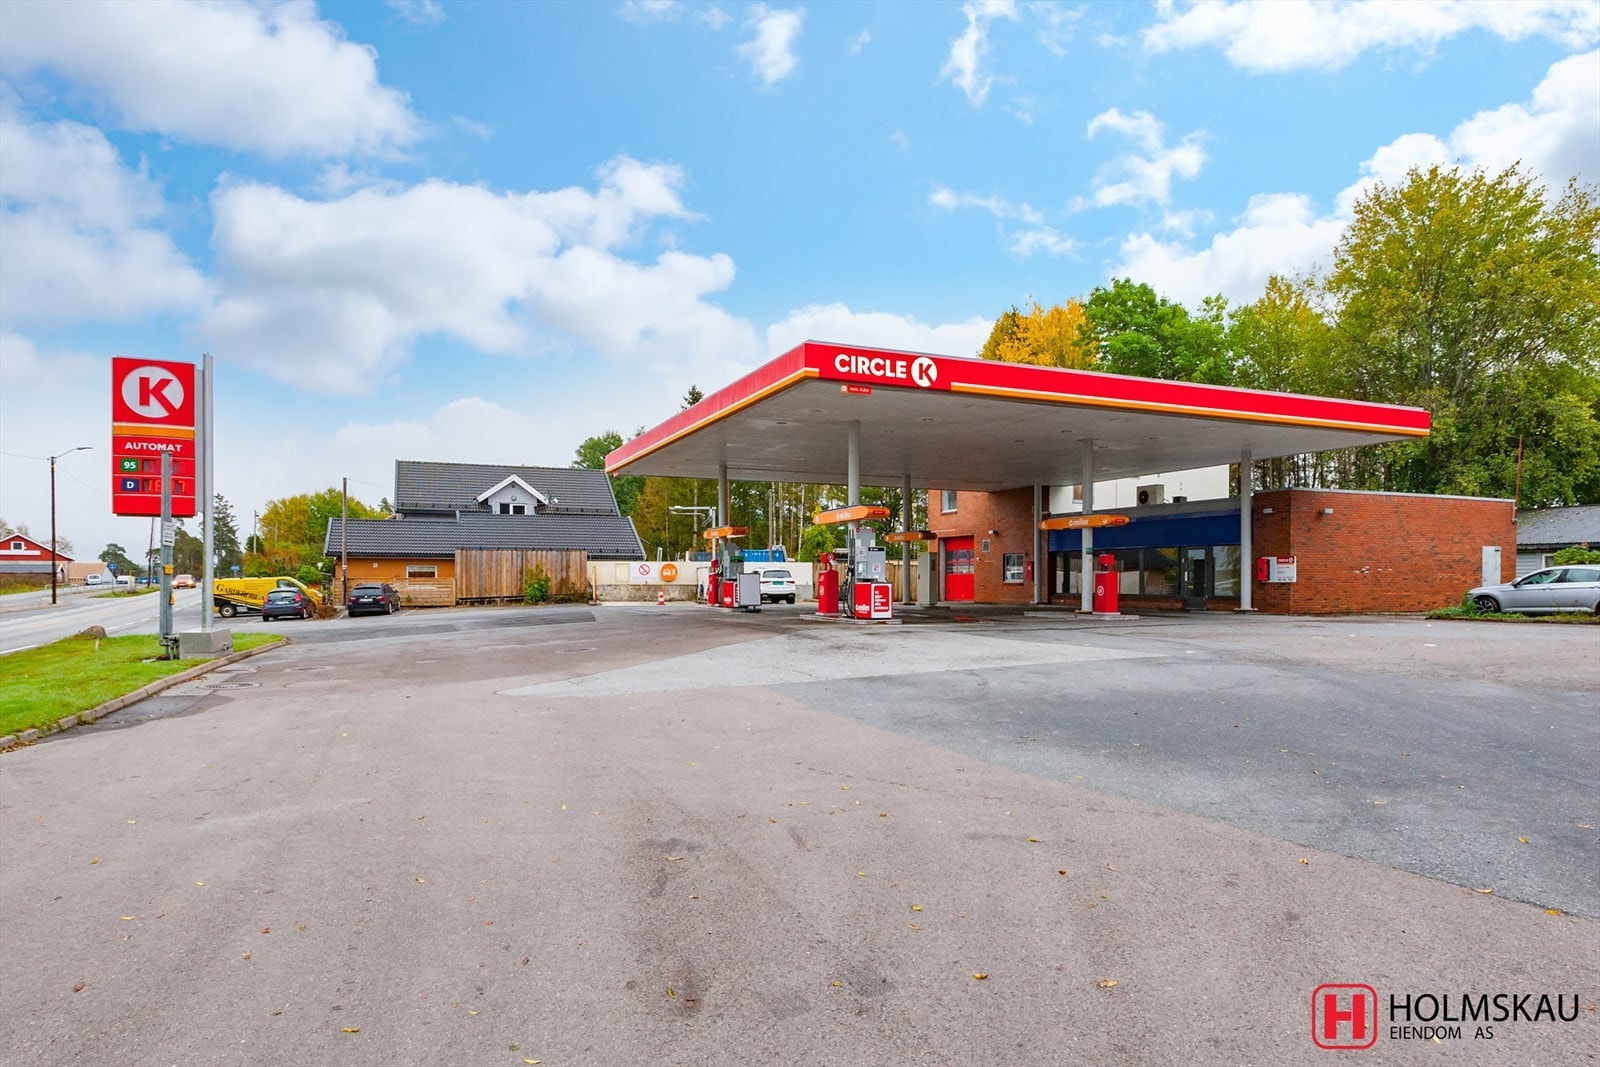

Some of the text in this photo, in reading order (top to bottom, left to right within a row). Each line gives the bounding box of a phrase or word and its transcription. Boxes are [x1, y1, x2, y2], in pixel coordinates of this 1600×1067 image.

[834, 353, 907, 379] CIRCLE
[124, 441, 183, 452] AUTOMAT
[123, 461, 137, 470] 95
[126, 481, 135, 489] D
